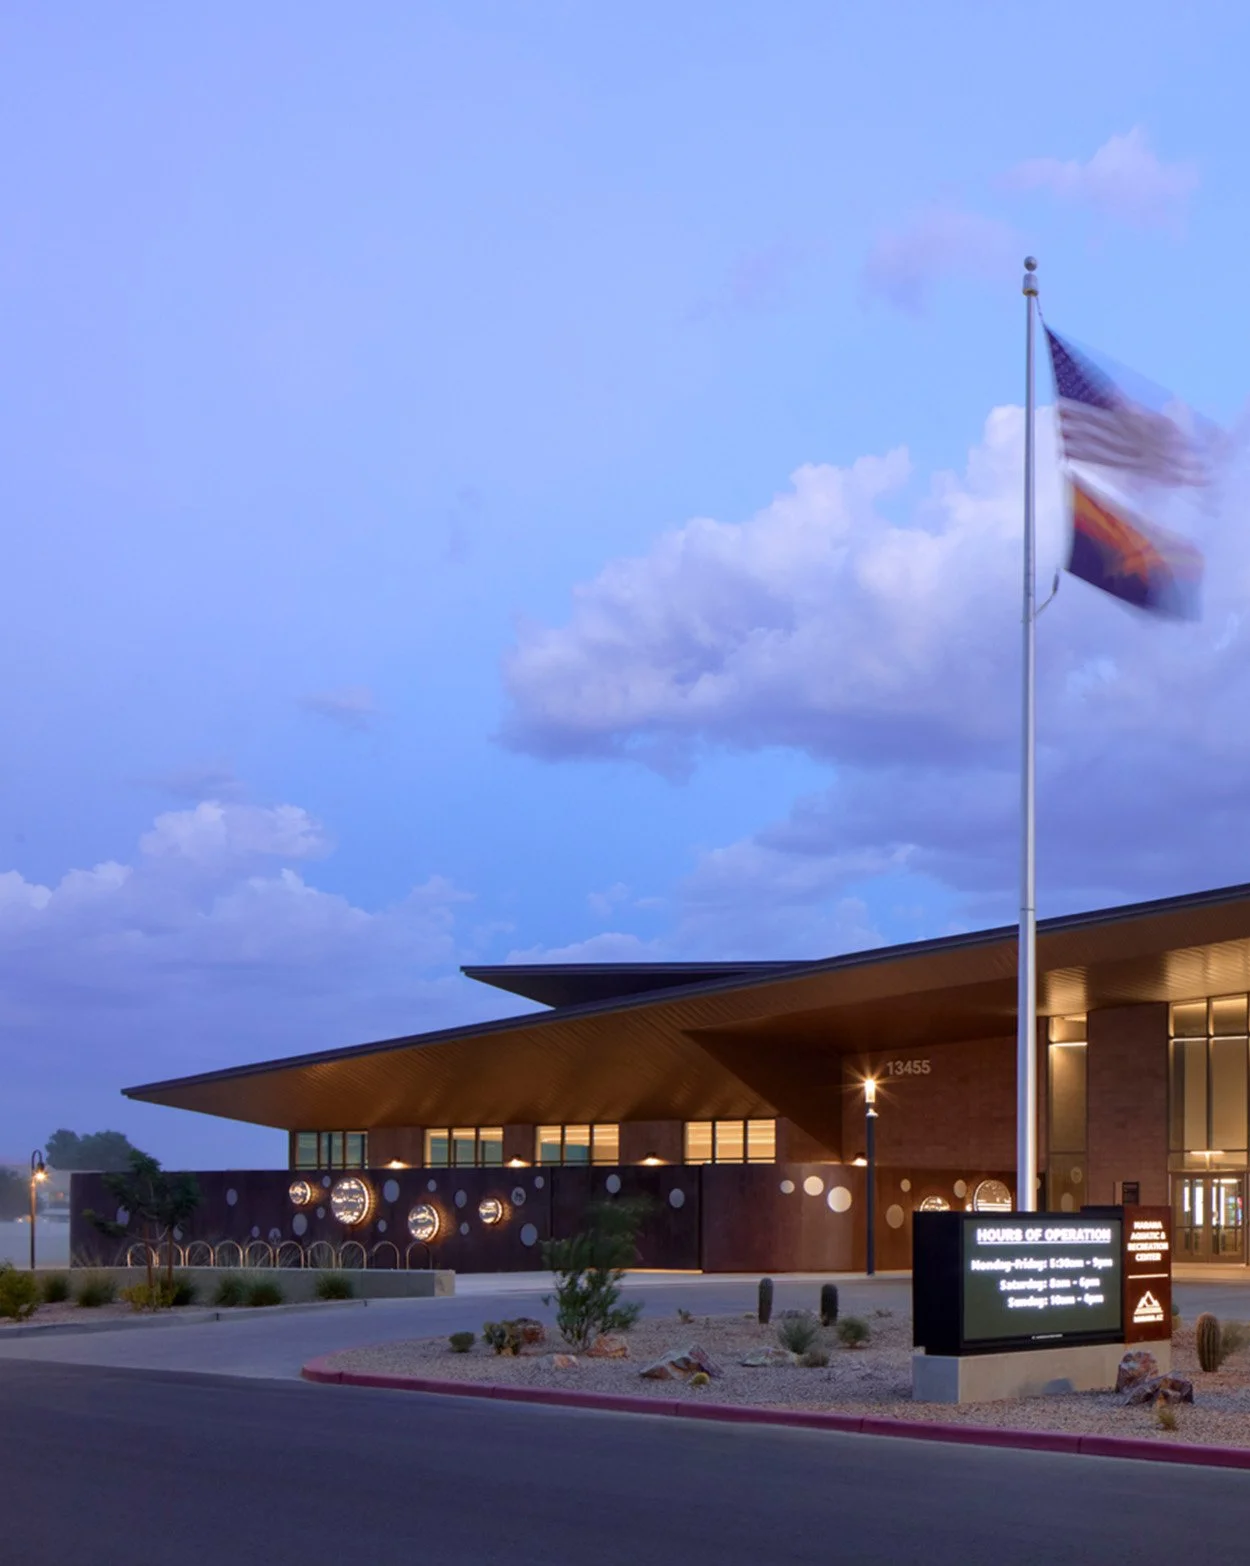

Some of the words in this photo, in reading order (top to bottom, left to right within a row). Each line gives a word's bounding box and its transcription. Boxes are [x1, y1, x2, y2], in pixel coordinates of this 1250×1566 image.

[886, 1060, 932, 1075] 13455
[977, 1228, 1023, 1242] HOURS
[1025, 1228, 1043, 1242] OF
[1044, 1228, 1111, 1241] OPERATION
[1130, 1231, 1160, 1241] AQUATIC
[1127, 1242, 1169, 1251] RECREATION
[1135, 1252, 1162, 1262] CENTER
[971, 1258, 1048, 1273] Monday-Friday:
[999, 1278, 1048, 1291] Saturday:
[1008, 1296, 1048, 1309] Sunday:
